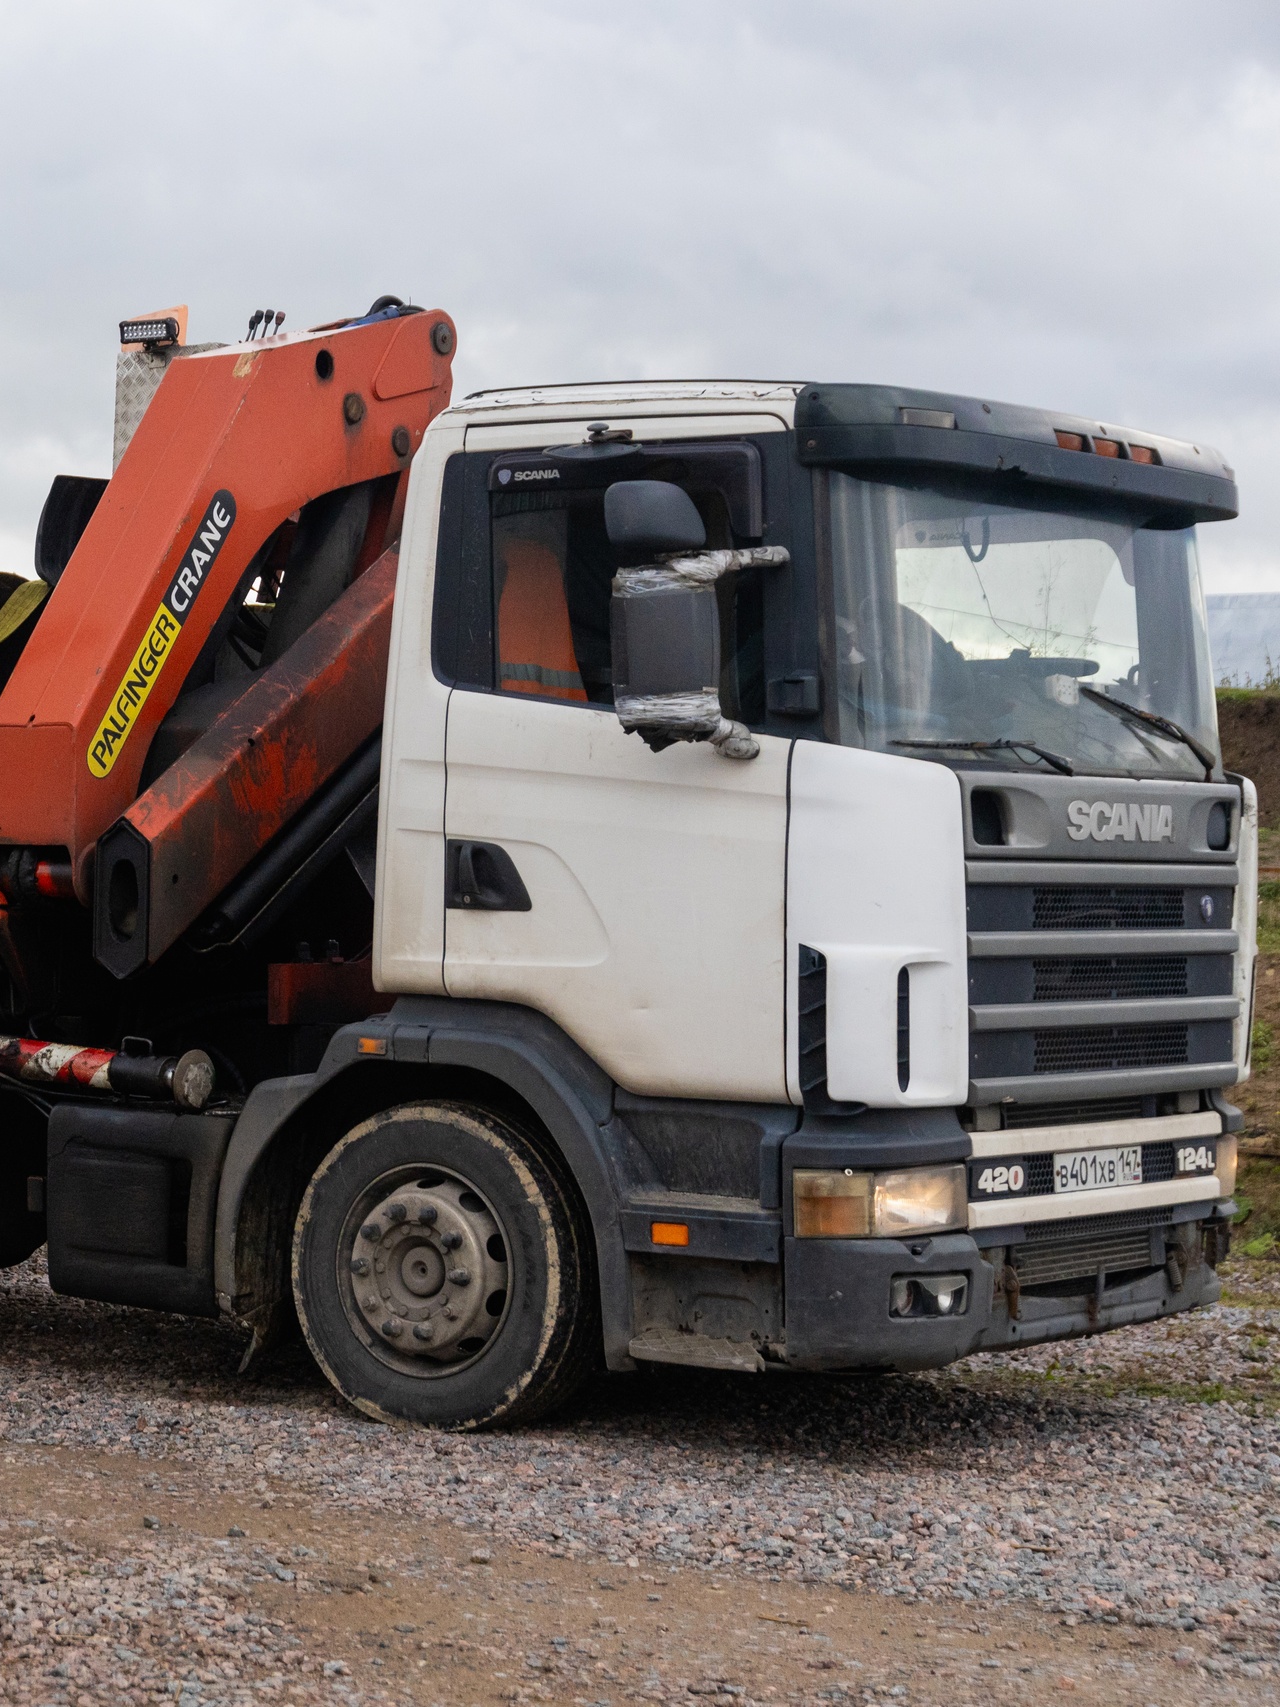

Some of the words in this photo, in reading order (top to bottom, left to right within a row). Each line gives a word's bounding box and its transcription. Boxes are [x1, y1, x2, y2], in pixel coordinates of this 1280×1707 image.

[514, 468, 561, 481] SCANIA
[91, 613, 176, 770] PALFINGER
[170, 500, 231, 613] CRANE
[1066, 800, 1176, 844] SCANIA
[1118, 1149, 1138, 1173] 147
[977, 1165, 1024, 1193] 420
